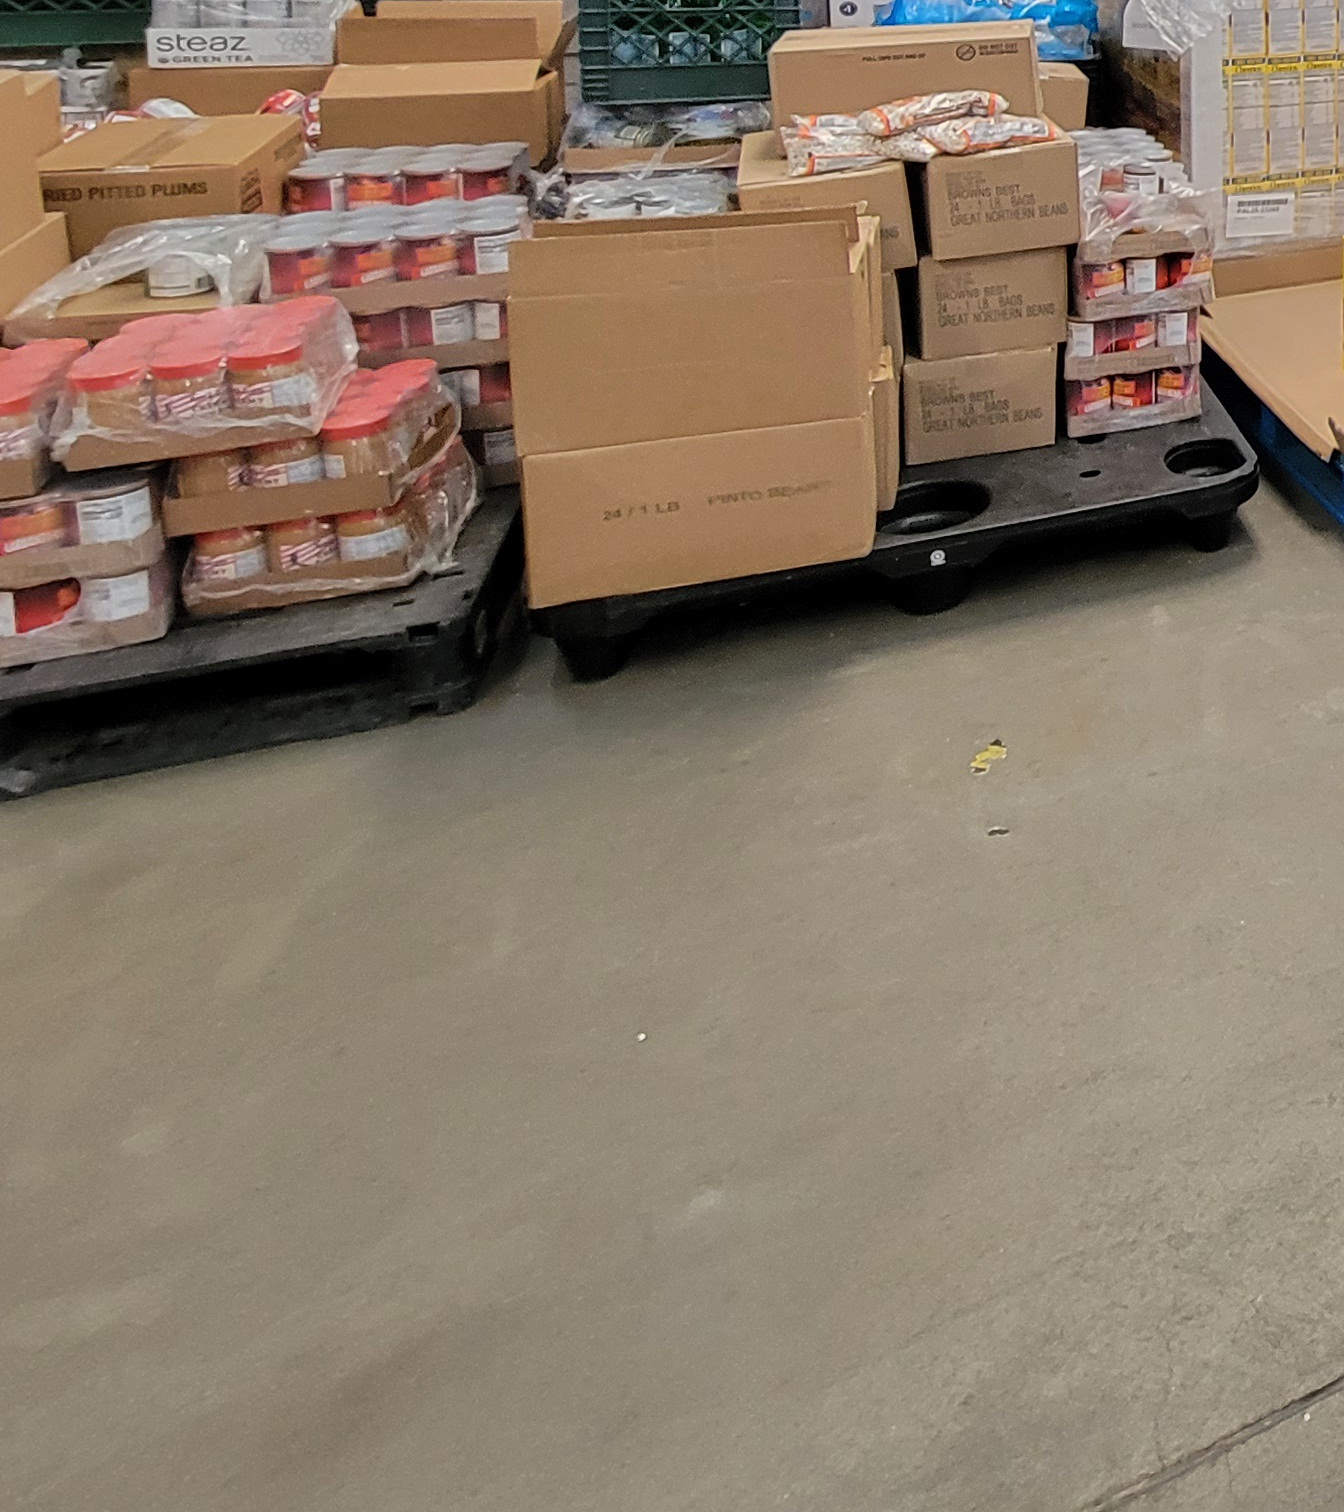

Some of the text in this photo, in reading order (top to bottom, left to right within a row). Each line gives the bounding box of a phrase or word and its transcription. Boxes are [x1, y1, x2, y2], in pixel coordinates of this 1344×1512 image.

[156, 33, 249, 53] steaz
[172, 54, 254, 64] GREEN TEA
[42, 180, 208, 202] RIED PITTED PLUMS
[948, 183, 1021, 200] BROWNS BEST
[1010, 191, 1036, 206] BAGS
[950, 200, 1069, 227] GREAT NORTHERN BEANS
[935, 284, 1009, 302] BROWNS BEST
[977, 298, 990, 310] LB
[998, 293, 1024, 308] BAGS
[938, 302, 1056, 328] GREAT NORTHERN BEANS
[968, 389, 995, 402] BEST
[602, 508, 623, 522] 24
[655, 500, 681, 514] LB
[706, 489, 765, 506] PINTO
